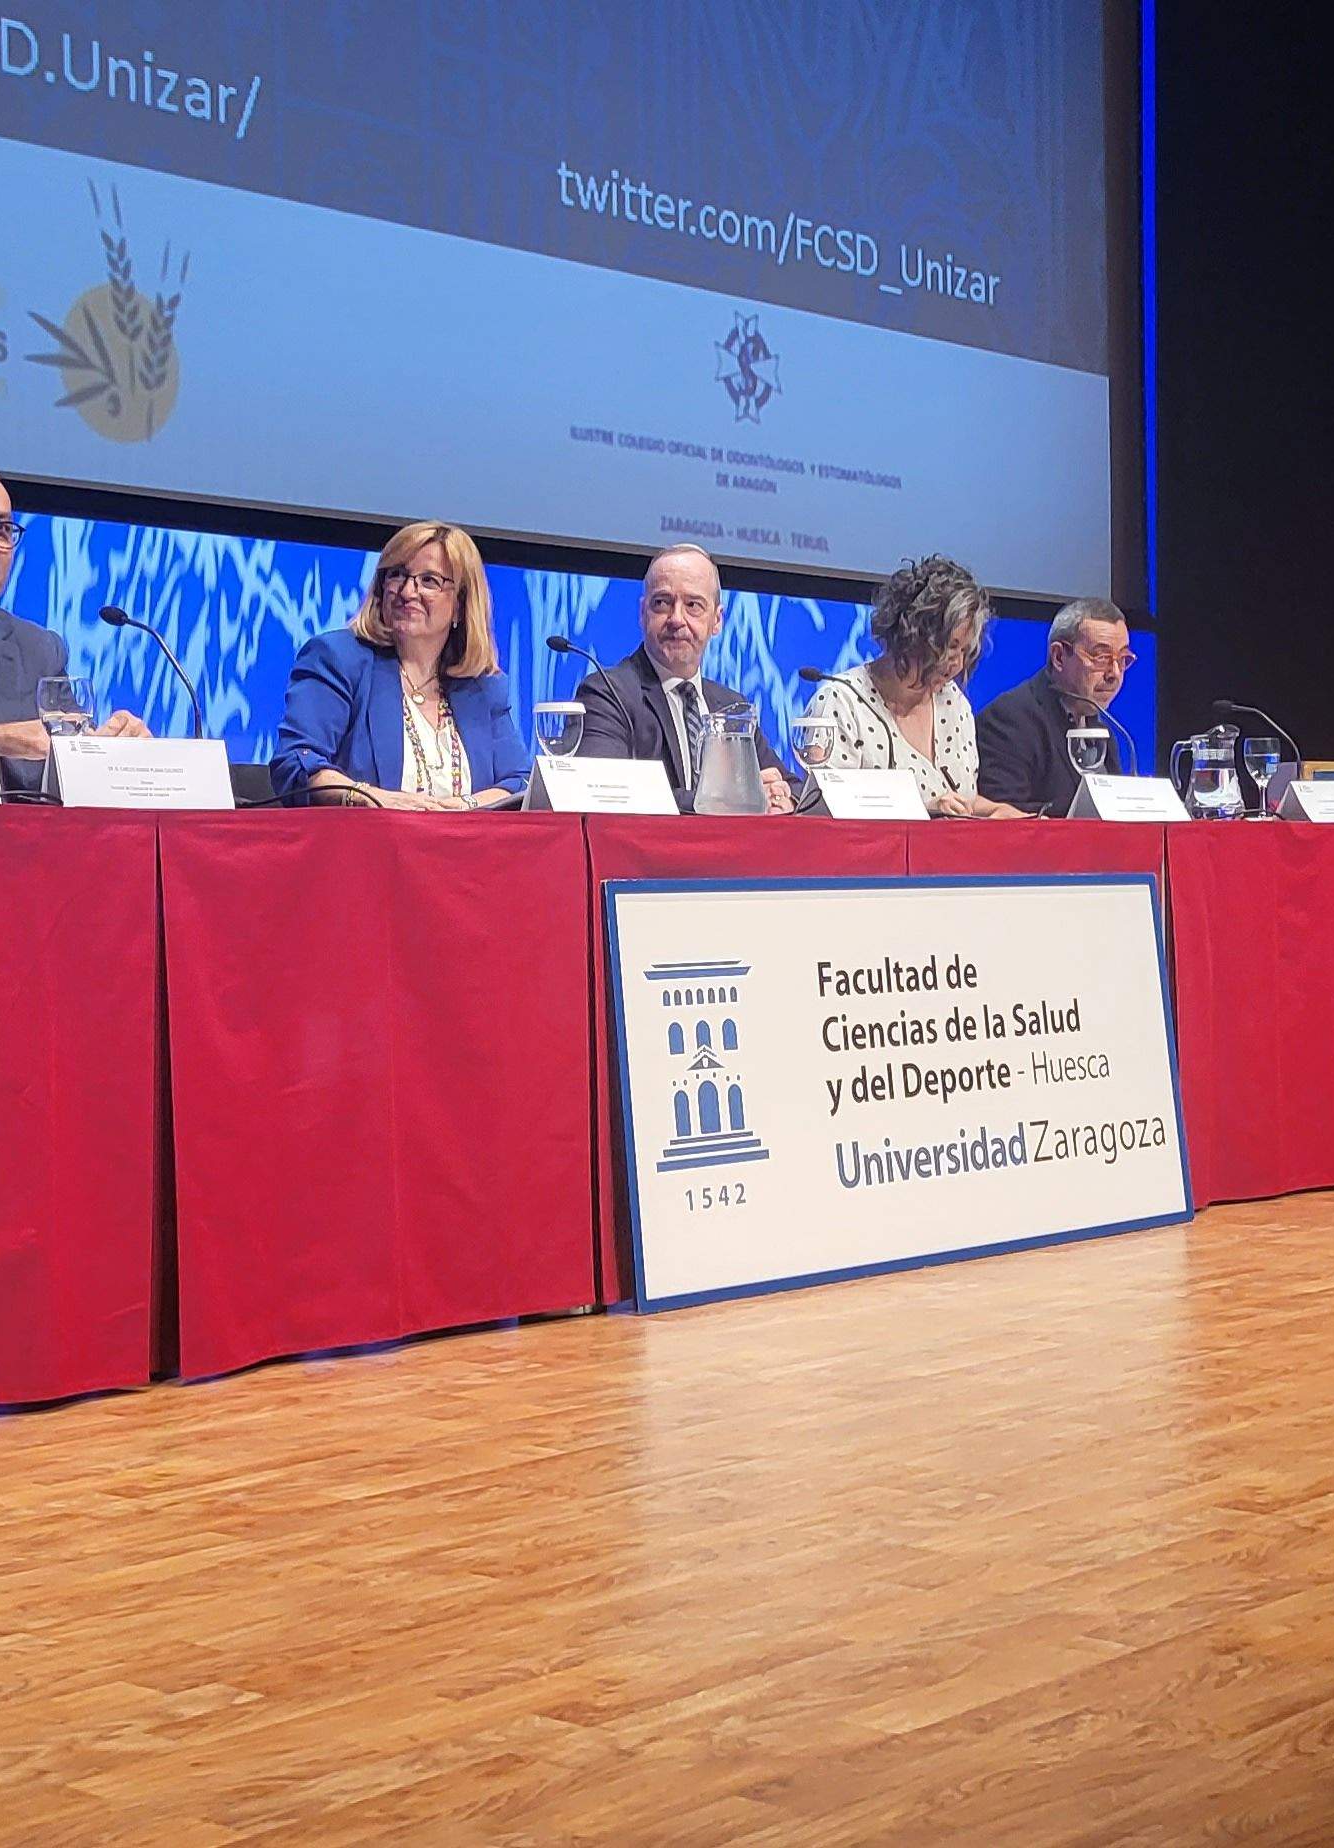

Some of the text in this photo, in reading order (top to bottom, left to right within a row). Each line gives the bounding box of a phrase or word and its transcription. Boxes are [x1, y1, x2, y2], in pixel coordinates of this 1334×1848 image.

[557, 160, 1000, 306] twitter.com/FCSD_Unizar
[618, 433, 665, 454] COLEGIO
[660, 515, 725, 539] ZARAGOZA
[817, 953, 978, 997] Facultad de
[822, 997, 1081, 1053] Ciencias de la Salud
[825, 1078, 843, 1117] y
[851, 1062, 895, 1104] del
[901, 1057, 1011, 1104] Deporte
[1031, 1050, 1110, 1085] Huesca
[835, 1115, 1166, 1189] Universidad Zaragoza
[685, 1182, 747, 1212] 1542
